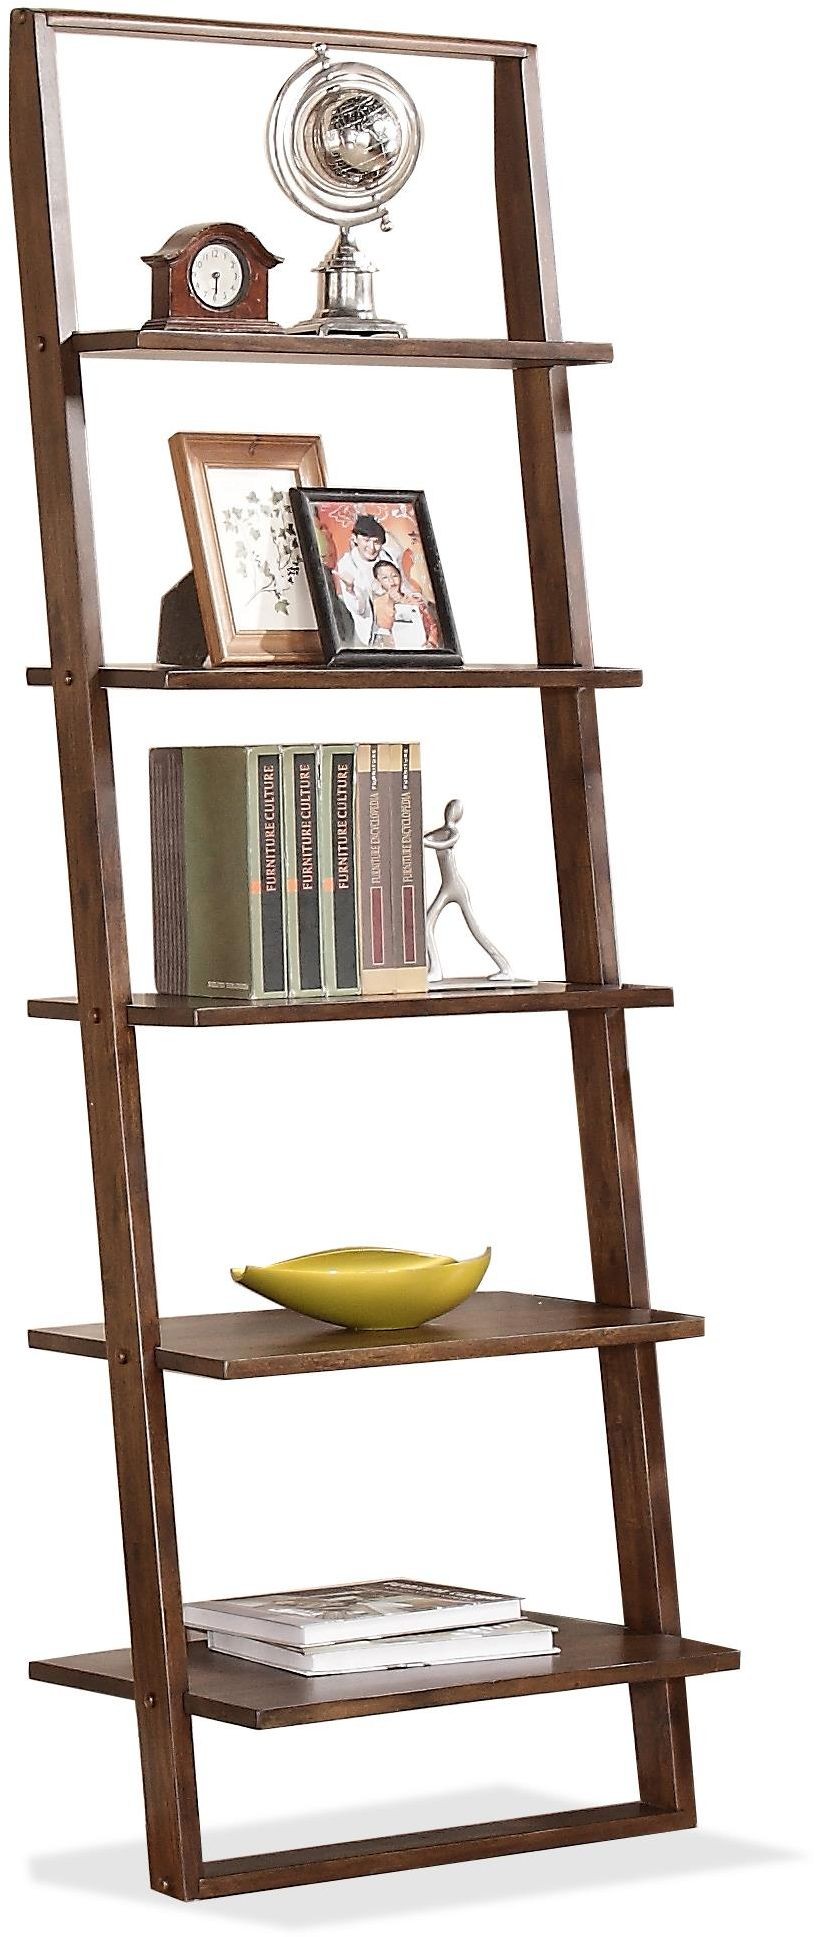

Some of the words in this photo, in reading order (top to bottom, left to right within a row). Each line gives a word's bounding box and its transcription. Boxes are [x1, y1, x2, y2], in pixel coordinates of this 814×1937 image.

[211, 249, 219, 258] 12
[263, 765, 275, 821] CULTURE
[299, 764, 311, 819] CULTURE
[336, 764, 348, 819] CULTURE
[265, 822, 278, 892] FURNITURE
[301, 820, 313, 890] FURNITURE
[337, 820, 349, 889] FURNITURE
